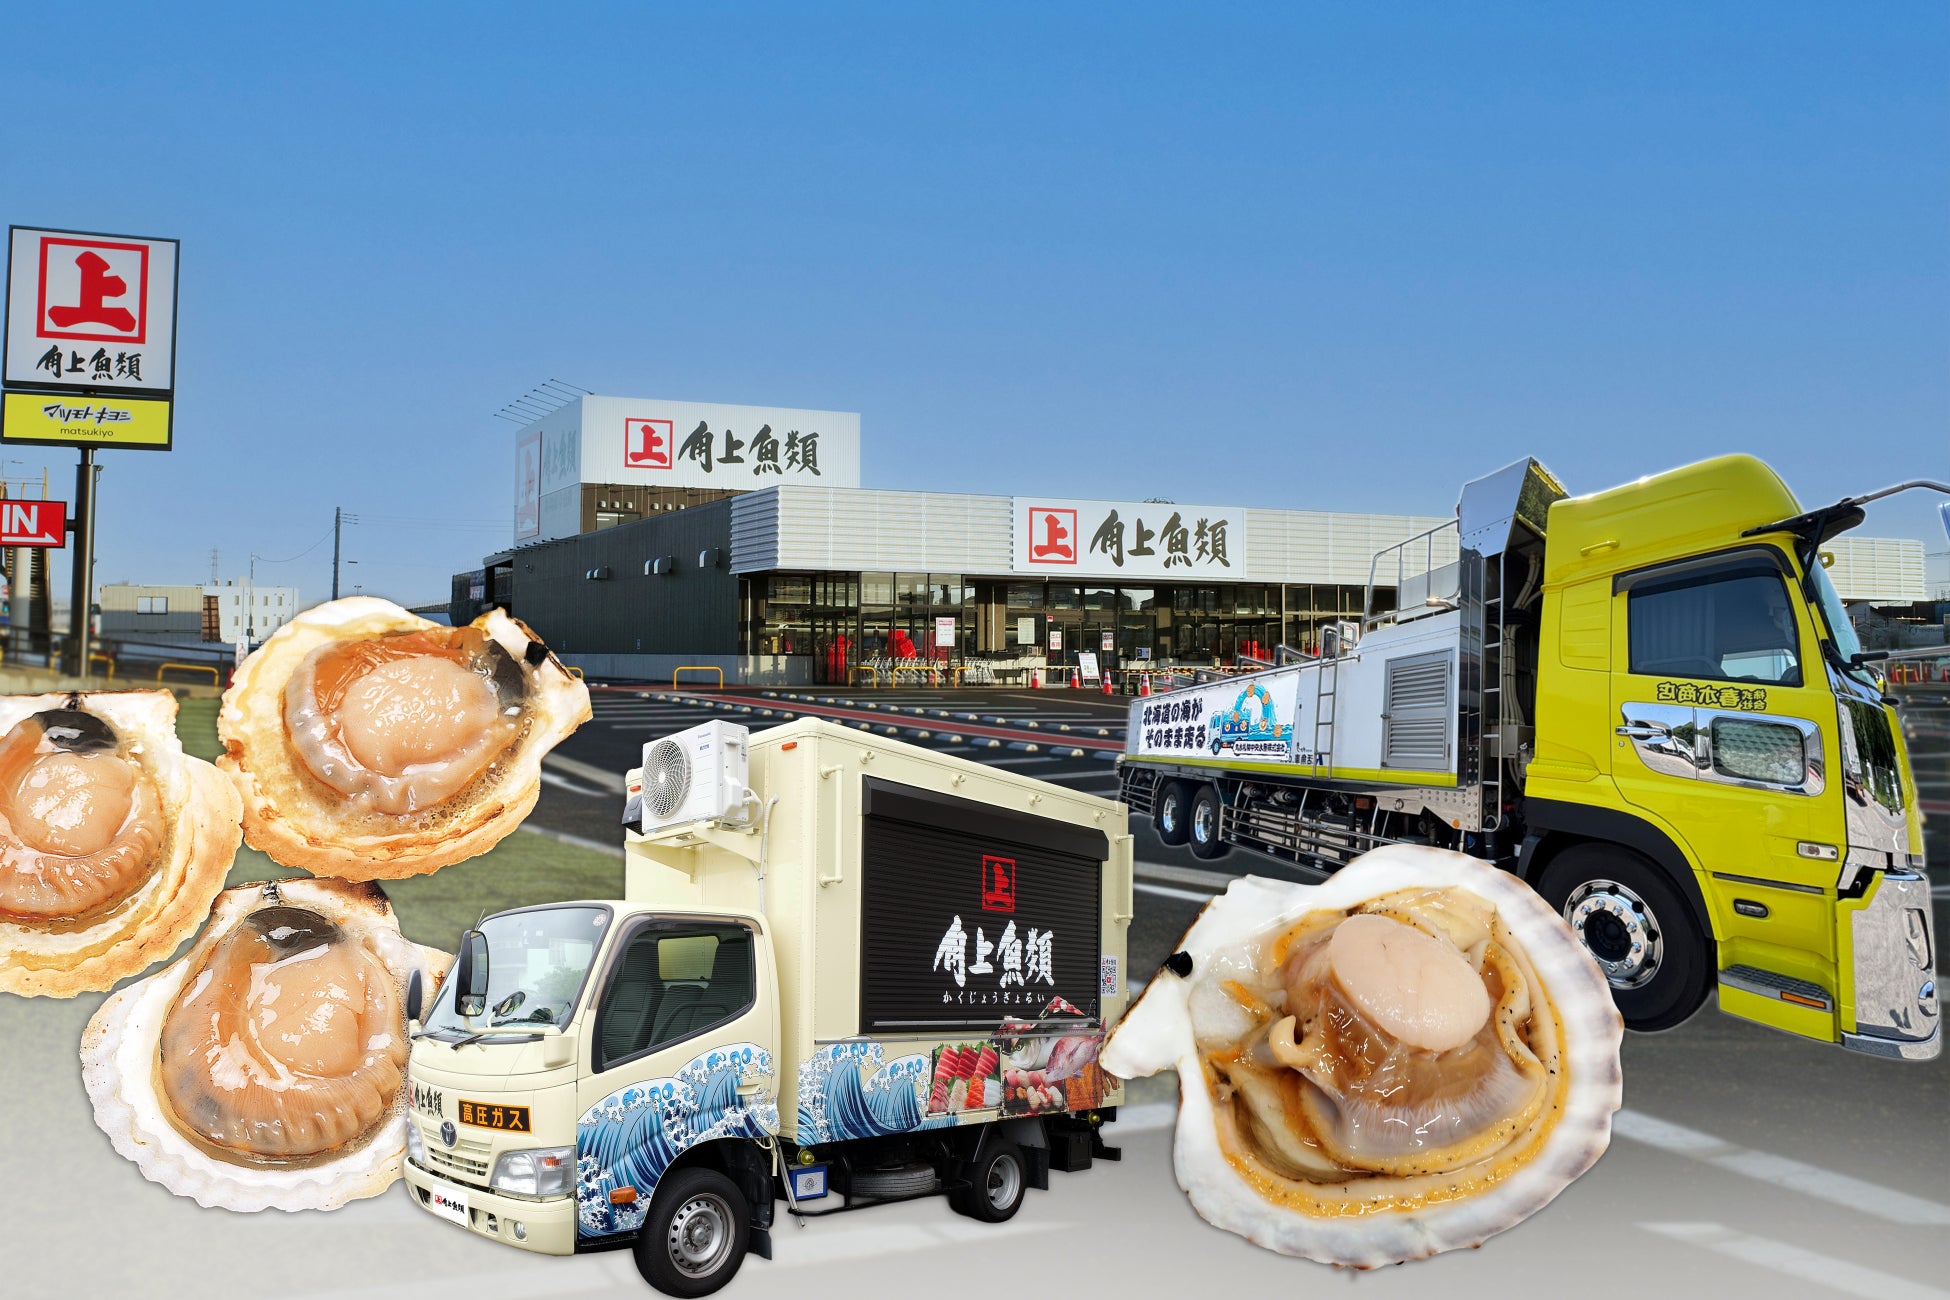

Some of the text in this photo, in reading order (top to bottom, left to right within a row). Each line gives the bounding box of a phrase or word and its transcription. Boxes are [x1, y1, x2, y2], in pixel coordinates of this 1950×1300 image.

[46, 249, 138, 334] 上
[36, 344, 143, 382] 角上魚類
[42, 402, 133, 425] マツモトキヨシ
[60, 426, 114, 438] matsukiyo
[628, 420, 821, 476] 上 角上魚類
[2, 504, 38, 534] IN
[1032, 508, 1230, 569] 上 角上魚類
[1142, 697, 1203, 726] 北海道の海が
[1145, 724, 1206, 749] そのまま走る
[984, 862, 1014, 907] 上
[933, 915, 1054, 988] 角上魚類
[942, 990, 1046, 1005] かくじょうぎょるい
[414, 1083, 443, 1119] 角上魚類
[463, 1104, 523, 1130] 高圧ガス
